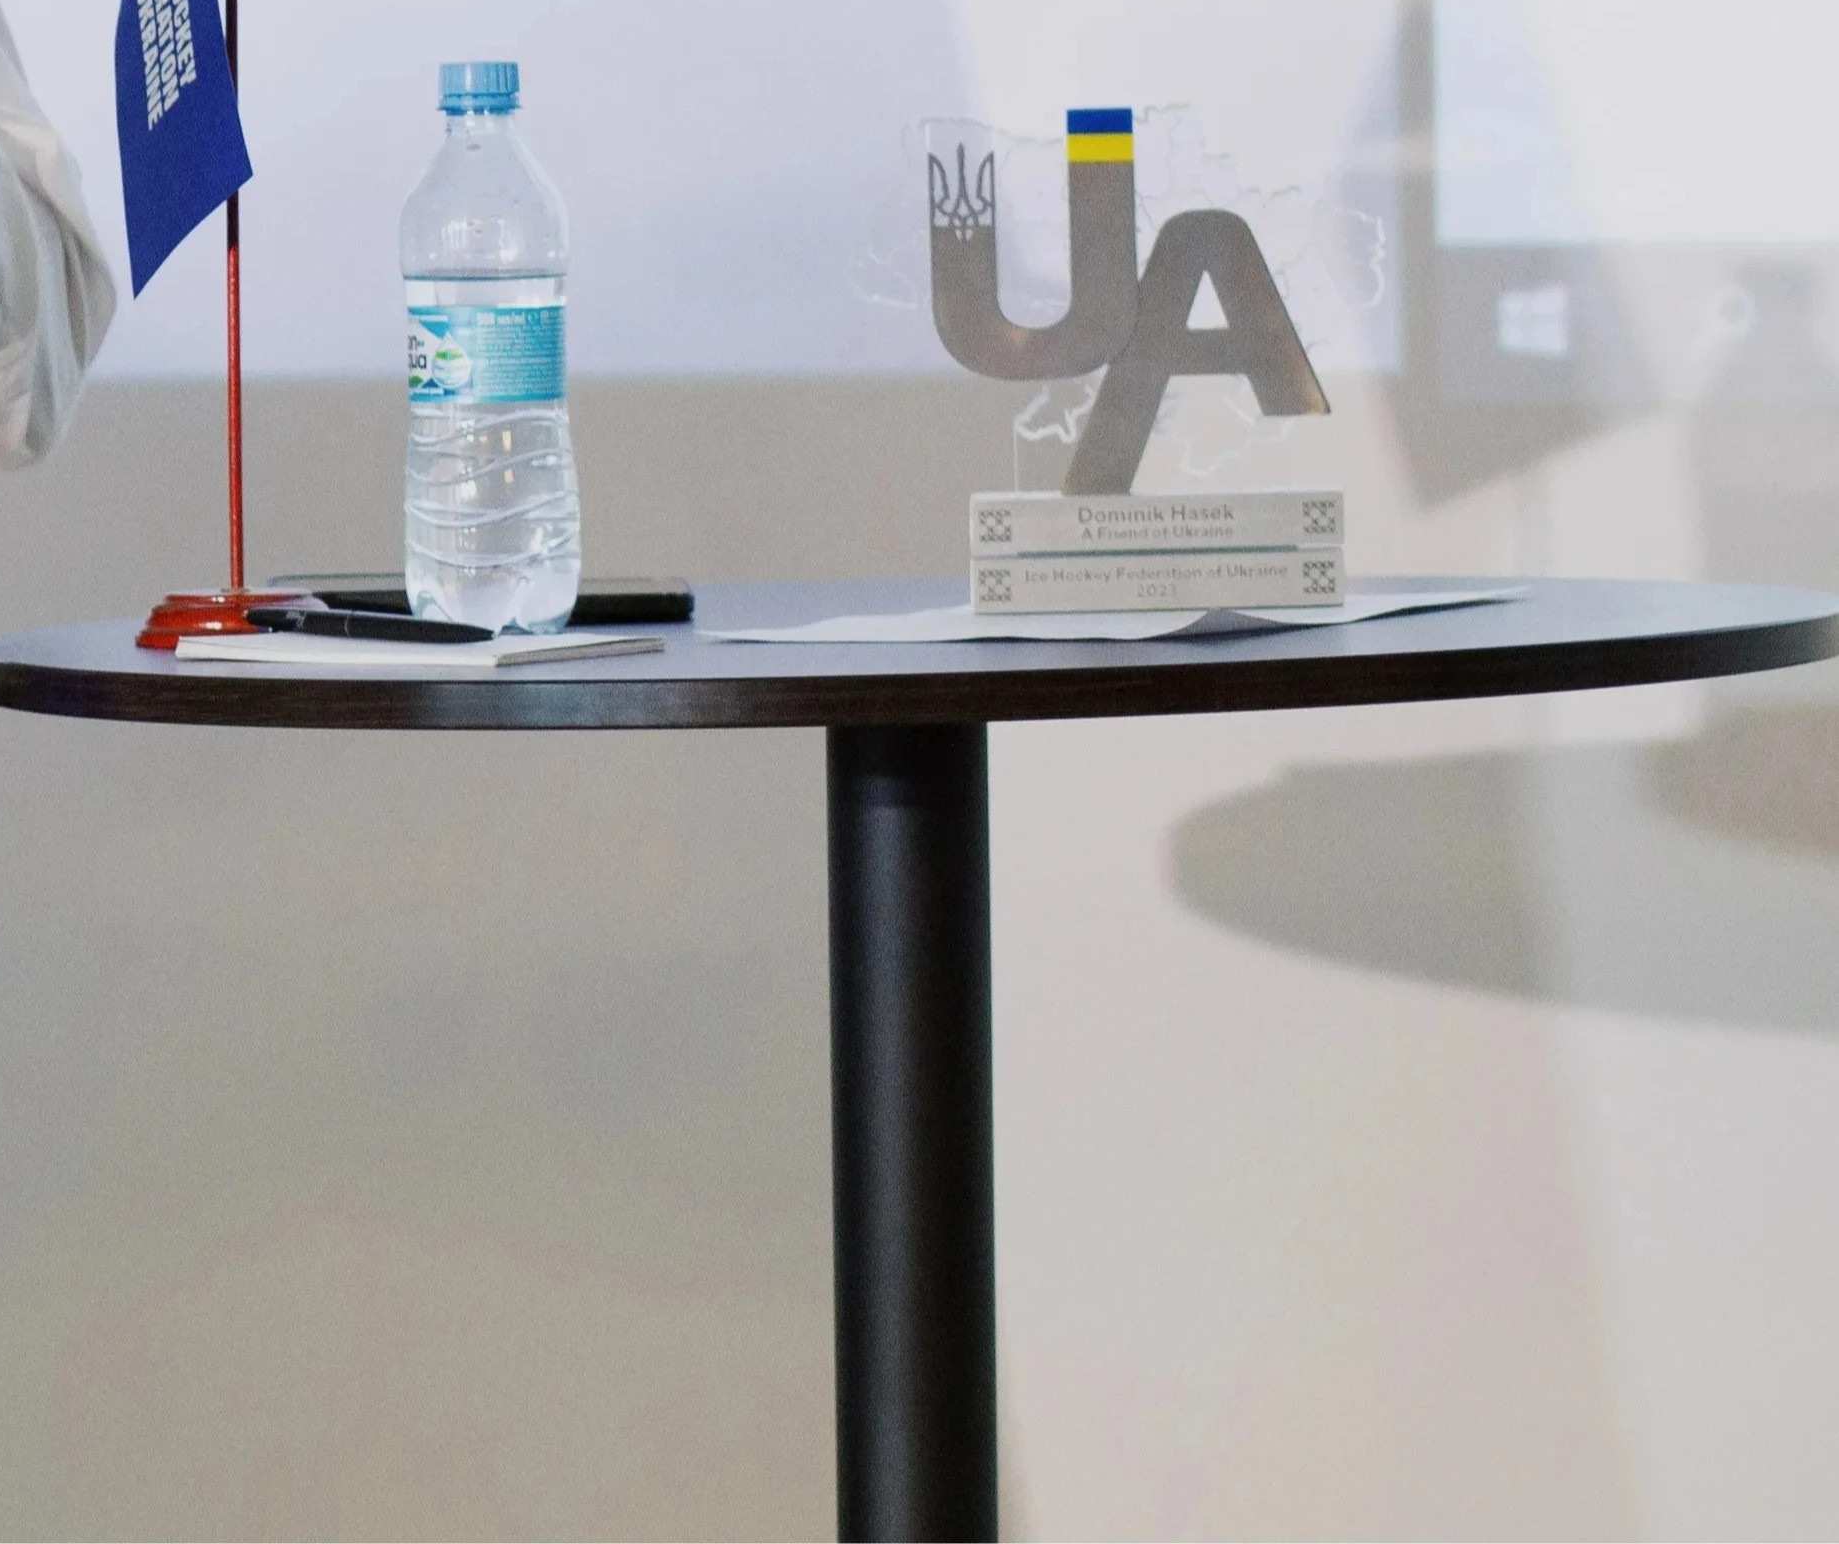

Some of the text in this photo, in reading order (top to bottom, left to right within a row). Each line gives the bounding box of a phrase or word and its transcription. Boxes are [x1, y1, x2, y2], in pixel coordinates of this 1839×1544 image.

[927, 108, 1331, 496] UA
[1078, 503, 1234, 523] Dominik Hasek
[1081, 524, 1234, 541] A Friend of Ukraine
[1025, 562, 1289, 584] Ice Hockey Federation of Ukraine
